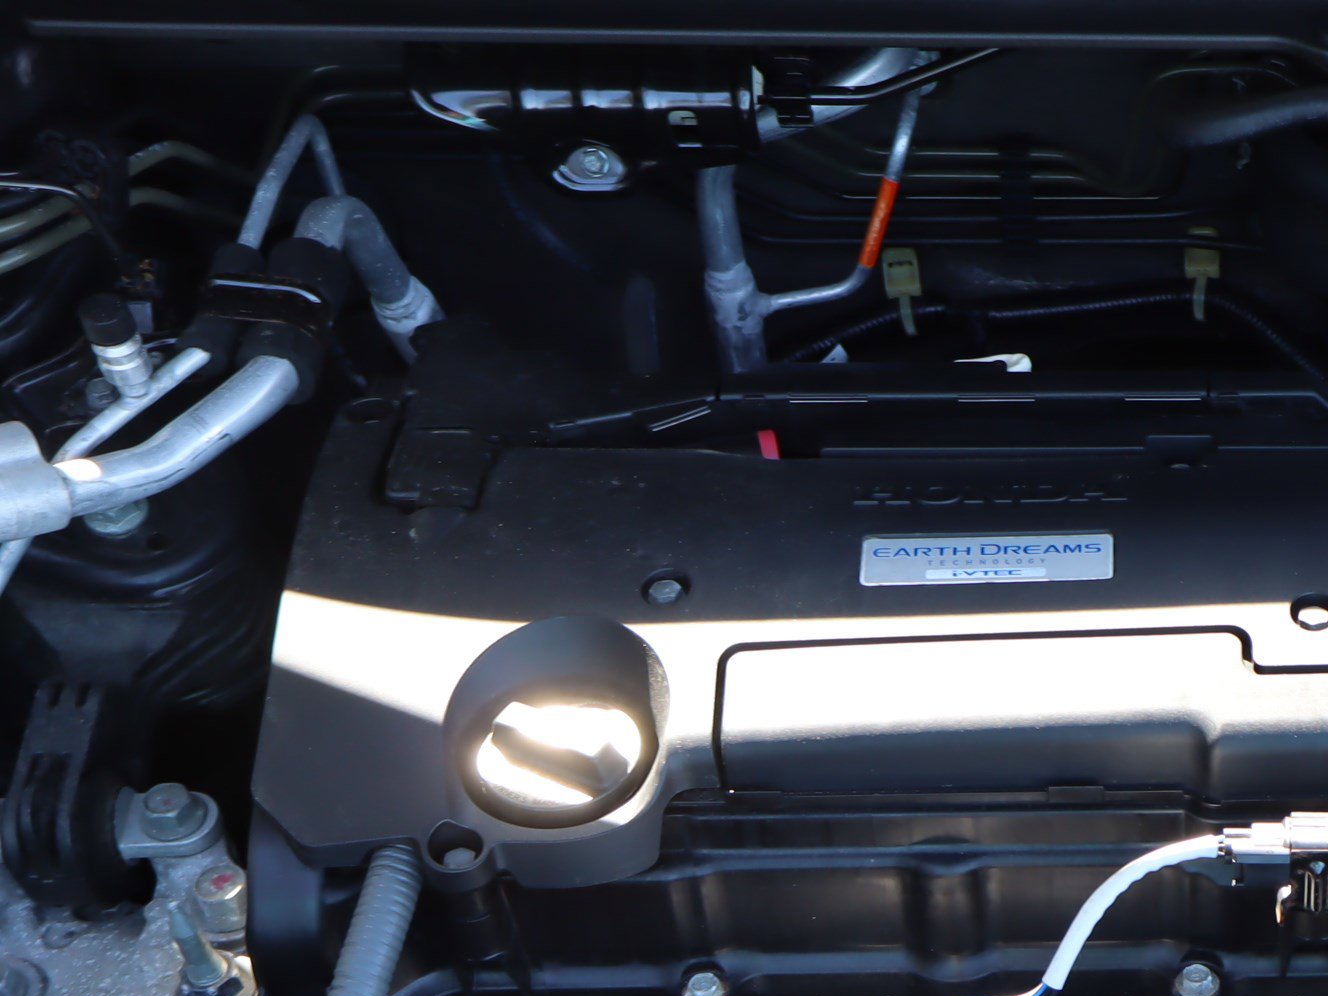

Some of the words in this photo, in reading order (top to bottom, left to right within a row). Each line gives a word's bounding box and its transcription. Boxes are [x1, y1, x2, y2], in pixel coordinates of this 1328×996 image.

[872, 546, 971, 558] EARTH
[980, 543, 1102, 556] DREAMS
[927, 558, 1046, 567] TECHNOLOGY
